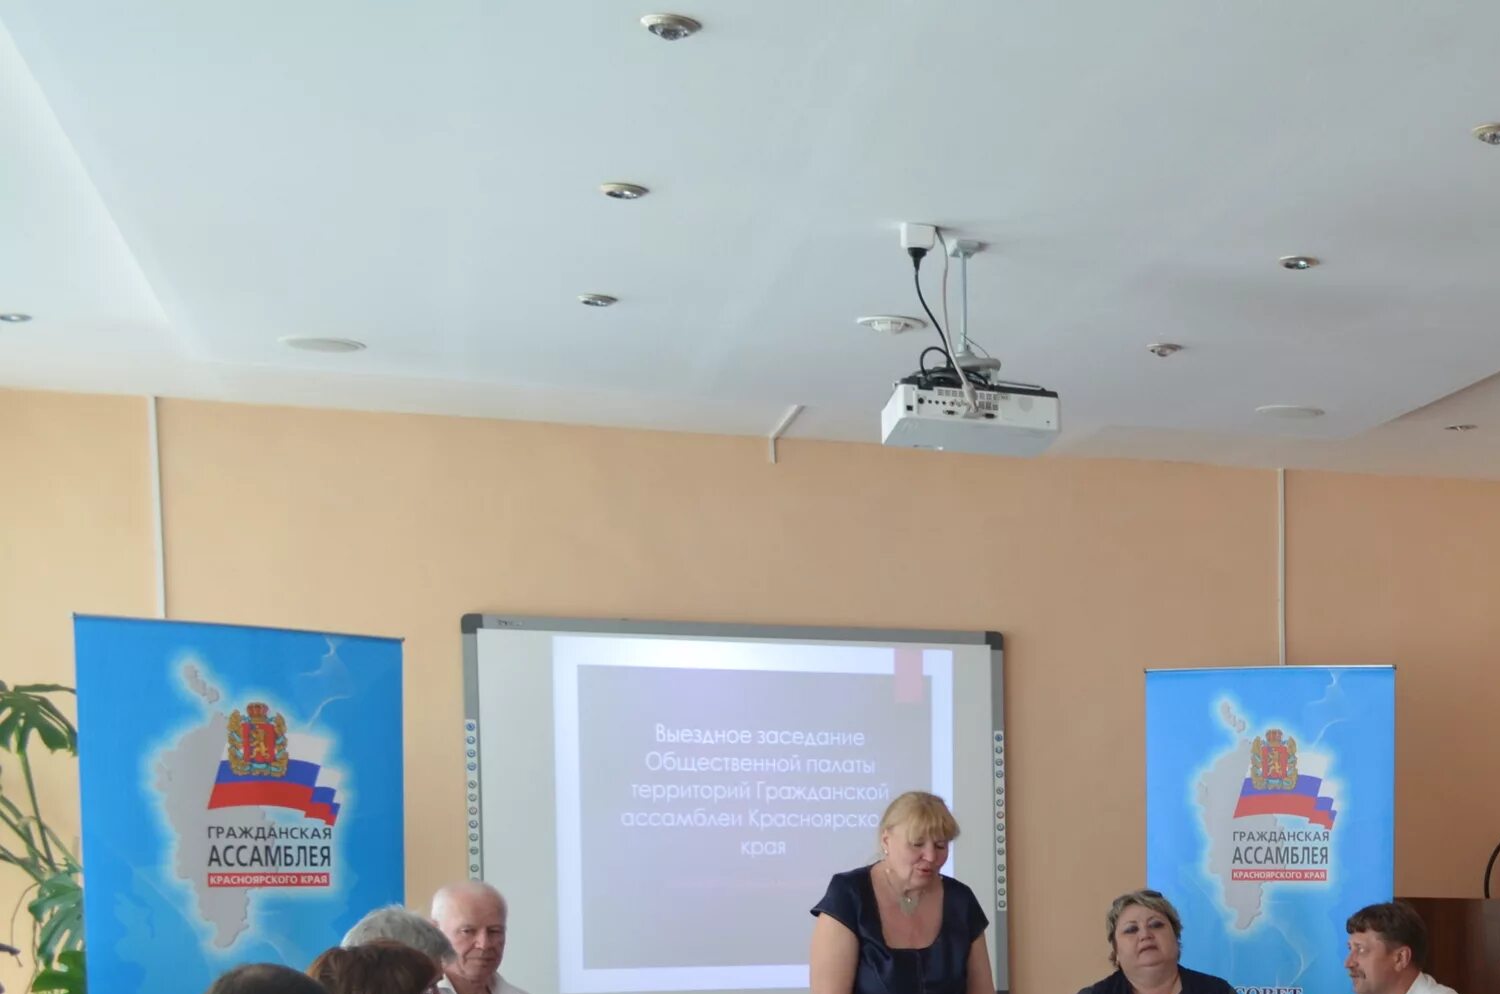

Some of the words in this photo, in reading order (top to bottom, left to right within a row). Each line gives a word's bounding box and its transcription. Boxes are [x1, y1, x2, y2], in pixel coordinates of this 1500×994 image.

[656, 723, 752, 745] Выездное
[757, 730, 865, 747] заседание
[645, 751, 801, 774] Общественной
[806, 758, 877, 774] палаты
[632, 781, 750, 803] территорий
[756, 781, 889, 804] Гражданской
[621, 808, 742, 827] ассамблеи
[748, 809, 880, 831] Красноярско
[208, 826, 332, 841] ГРАЖДАНСКАЯ
[1233, 831, 1329, 843] ГРАЖДАНСКАЯ
[208, 845, 331, 867] АССАМБЛЕЯ
[741, 840, 786, 857] края
[1232, 846, 1328, 864] АССАМБЛЕЯ
[209, 875, 298, 885] КРАСНОЯРСКОГО
[300, 874, 328, 884] КРАЯ
[1233, 871, 1302, 880] КРАСНОЯРСКОГО
[1304, 871, 1326, 880] КРАЯ
